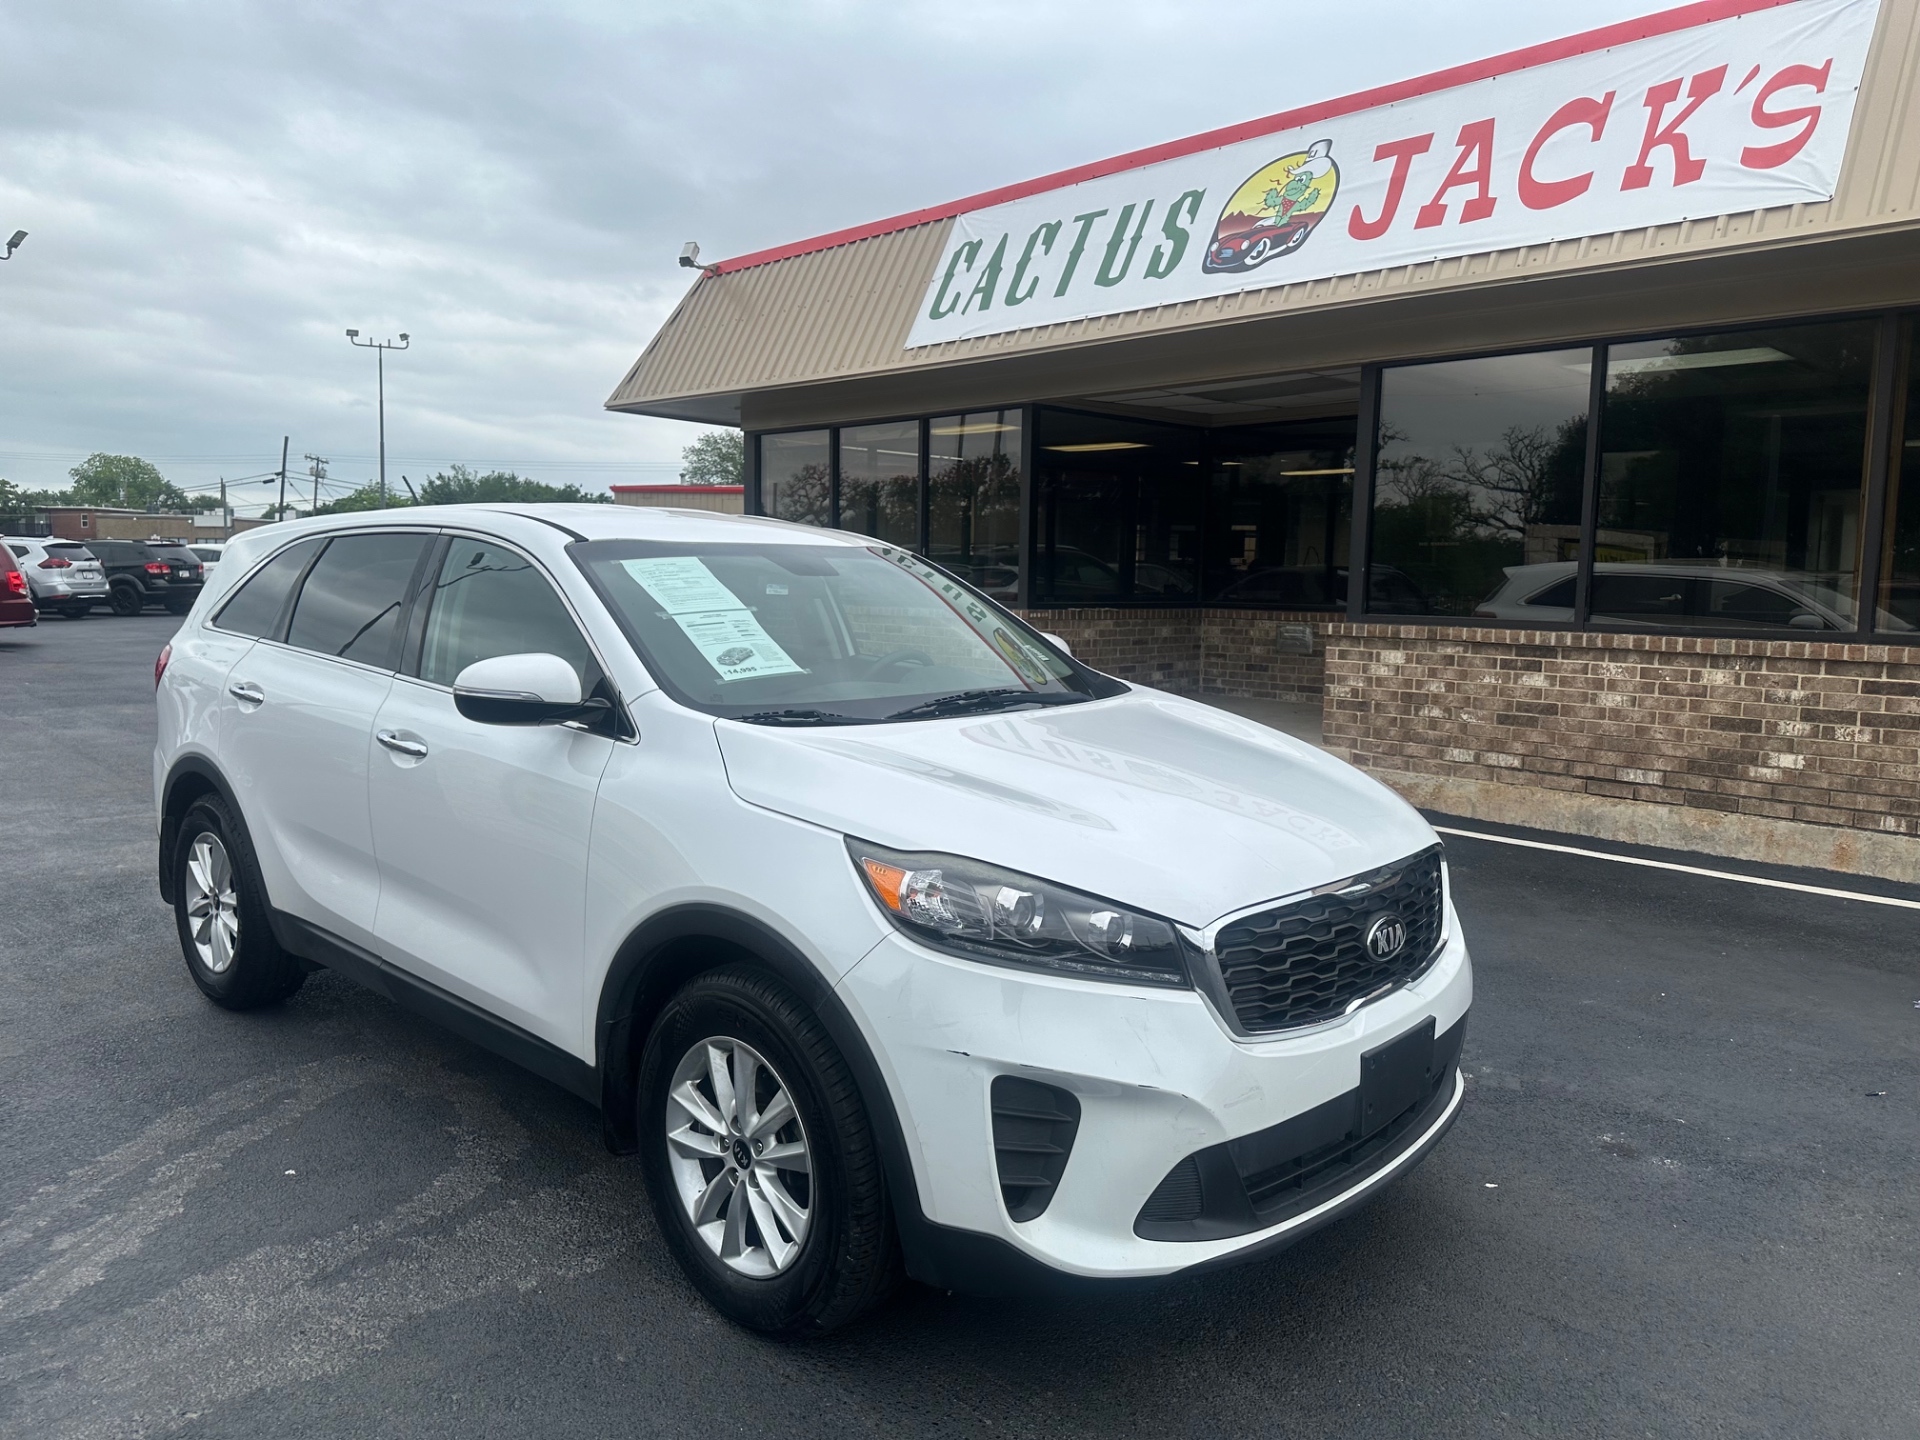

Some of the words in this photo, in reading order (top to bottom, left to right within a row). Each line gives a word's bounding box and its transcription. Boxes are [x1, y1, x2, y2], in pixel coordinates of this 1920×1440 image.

[929, 188, 1207, 320] CACTUS
[1347, 57, 1834, 241] JACK'S
[1376, 923, 1404, 955] KIA
[734, 1142, 748, 1167] KIA
